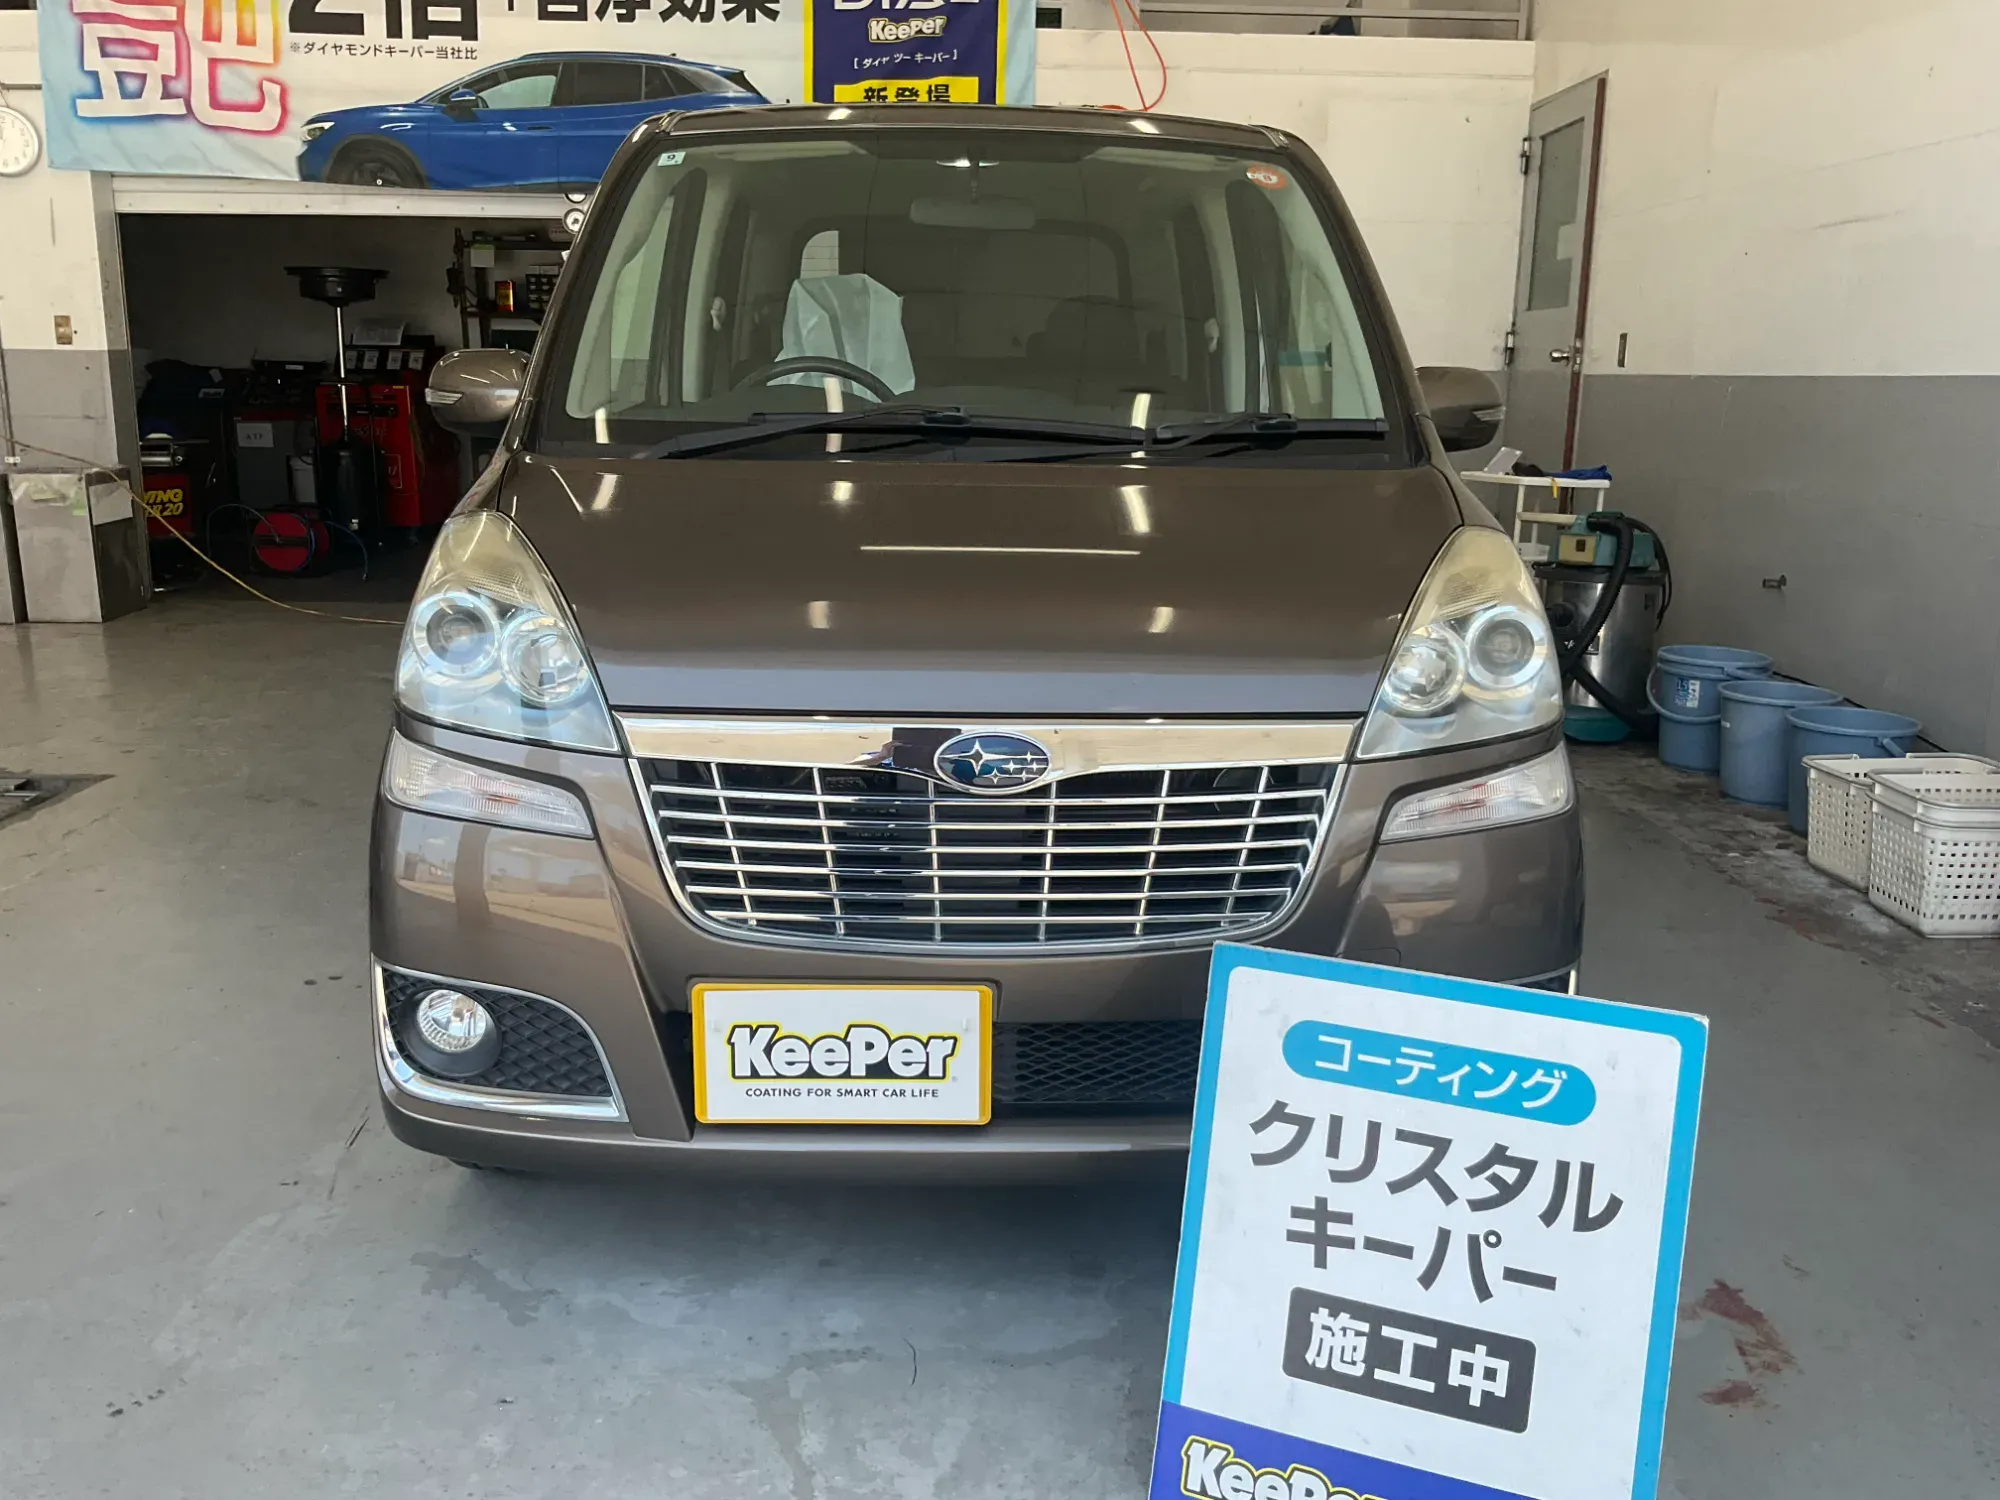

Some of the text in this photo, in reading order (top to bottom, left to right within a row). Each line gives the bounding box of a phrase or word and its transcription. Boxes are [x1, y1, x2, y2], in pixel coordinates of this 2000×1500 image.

[868, 17, 946, 43] KeePer
[728, 1025, 958, 1079] KeePer
[1314, 1034, 1569, 1111] コーティング
[745, 1087, 939, 1098] COATING FOR SMART CAR LIFE
[1248, 1098, 1624, 1233] クリスタル
[1284, 1195, 1558, 1304] キーパー
[1303, 1306, 1511, 1409] 施工中
[1183, 1437, 1372, 1500] KeeP
